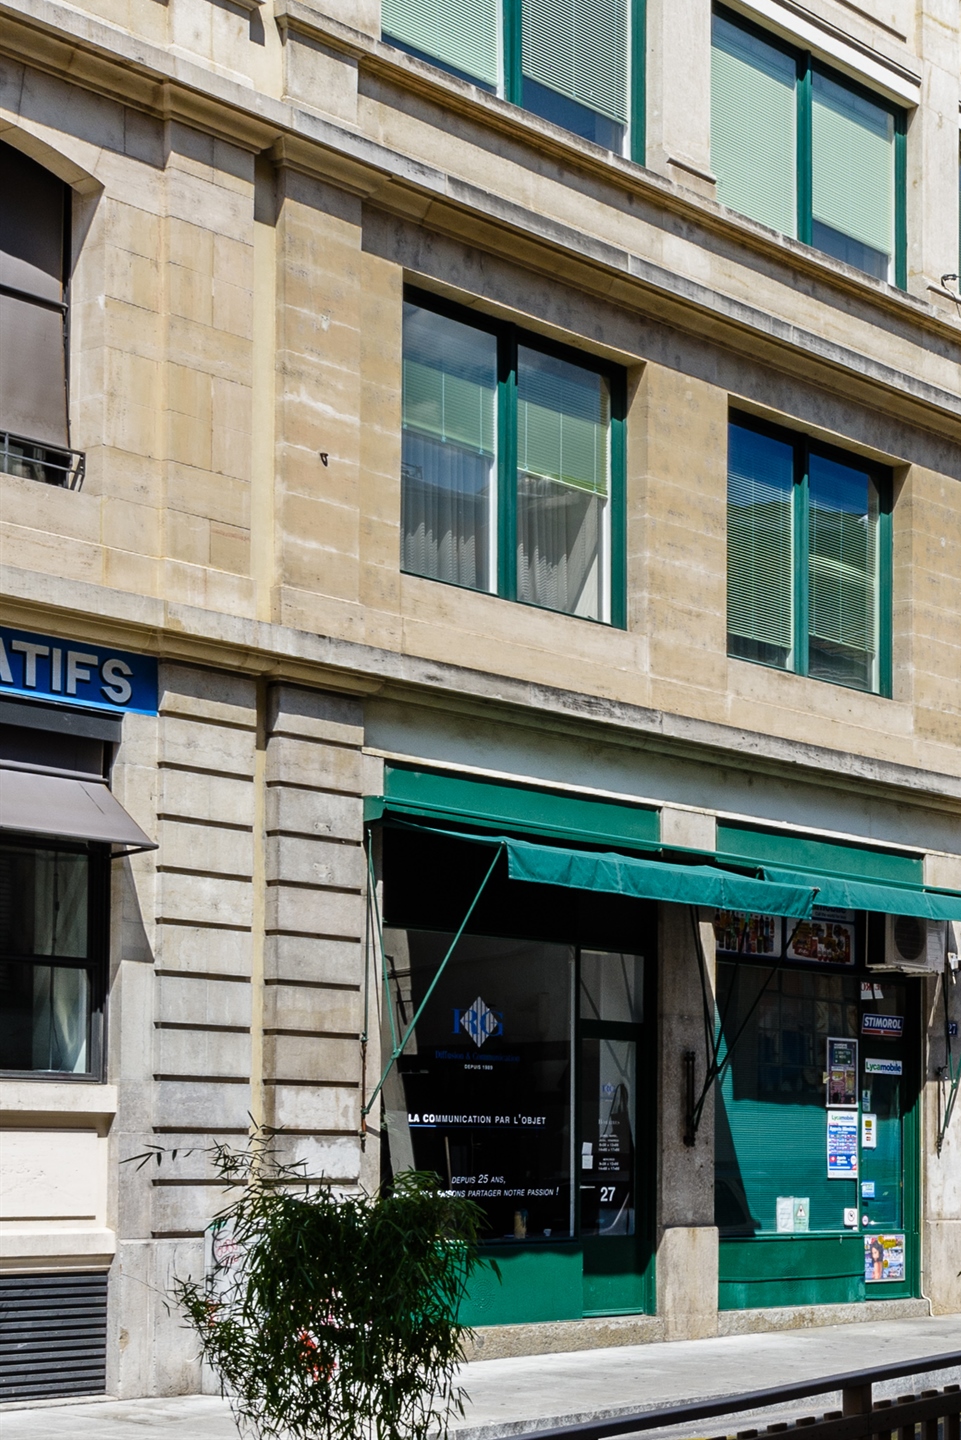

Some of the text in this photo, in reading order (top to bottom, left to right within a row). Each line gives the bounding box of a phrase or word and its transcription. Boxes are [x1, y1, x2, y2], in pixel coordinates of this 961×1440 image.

[864, 1016, 902, 1029] STIMOROL
[865, 1061, 902, 1072] Lycamobile
[408, 1114, 547, 1125] LA COMMUNICATION PAR L'OBJET
[451, 1174, 507, 1185] DEPUIS 25 ANS,
[467, 1190, 502, 1198] PARTAGER
[503, 1189, 525, 1197] NOTRE
[527, 1188, 554, 1197] PASSION
[600, 1186, 616, 1202] 27
